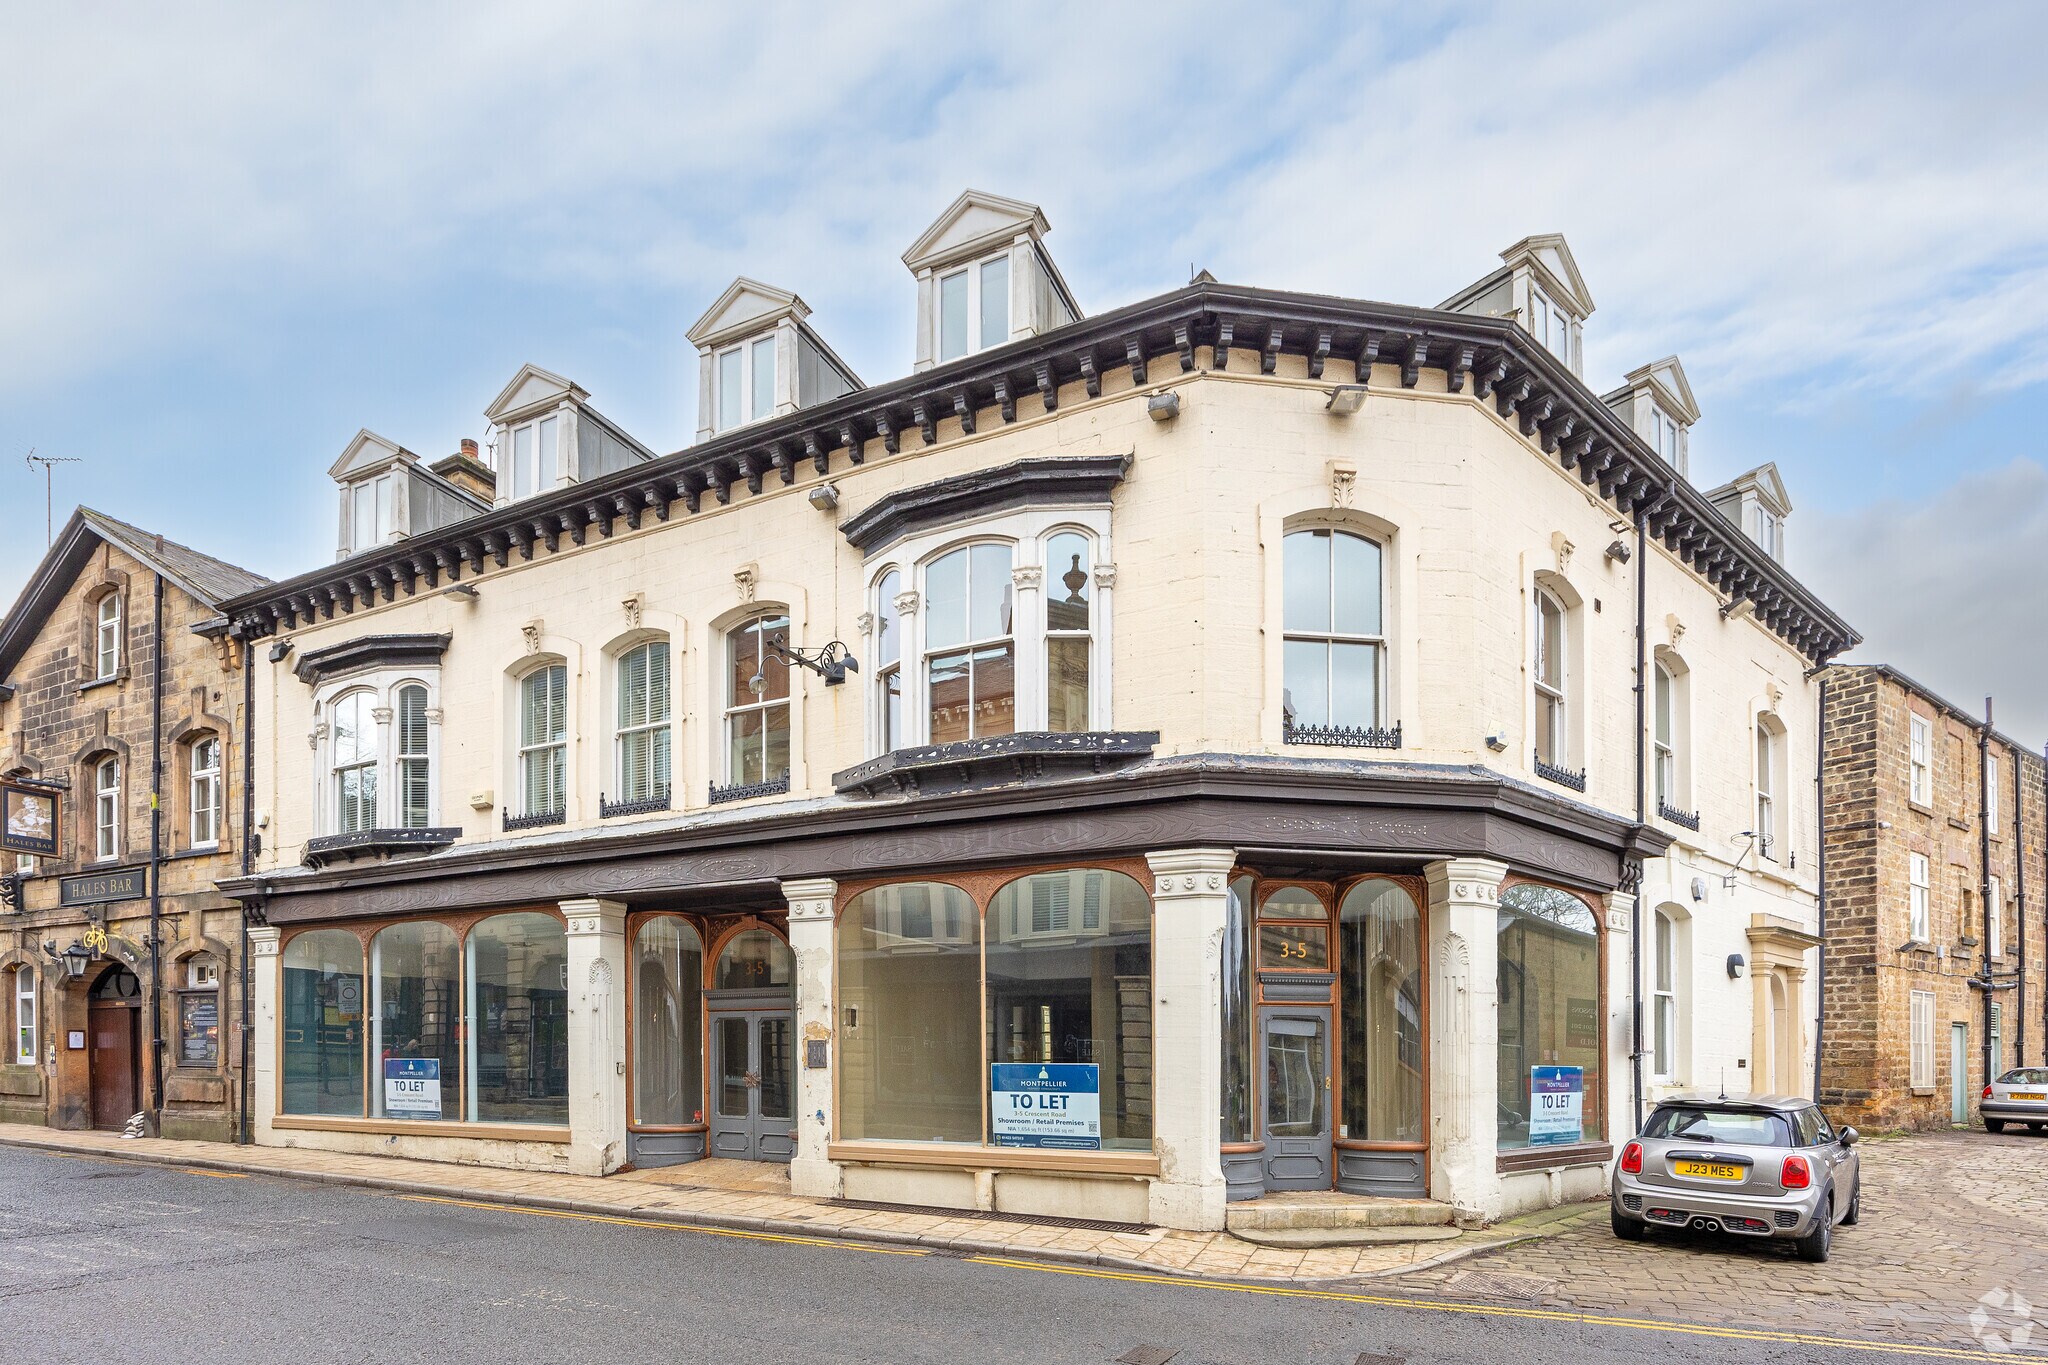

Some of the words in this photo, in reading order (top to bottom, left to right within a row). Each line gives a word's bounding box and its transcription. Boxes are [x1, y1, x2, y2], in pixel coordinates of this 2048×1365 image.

[6, 837, 34, 847] HALES
[36, 841, 53, 850] BAR
[72, 881, 106, 897] HALES
[110, 878, 132, 893] BAR
[1280, 941, 1307, 959] 3-5
[745, 961, 764, 975] 3-5
[394, 1080, 406, 1092] TO
[409, 1080, 425, 1092] LET
[1010, 1094, 1033, 1109] TO
[1039, 1094, 1070, 1110] LET
[1541, 1094, 1553, 1109] TO
[1556, 1094, 1570, 1109] LET
[1685, 1163, 1708, 1175] J23
[1710, 1164, 1734, 1177] MES
